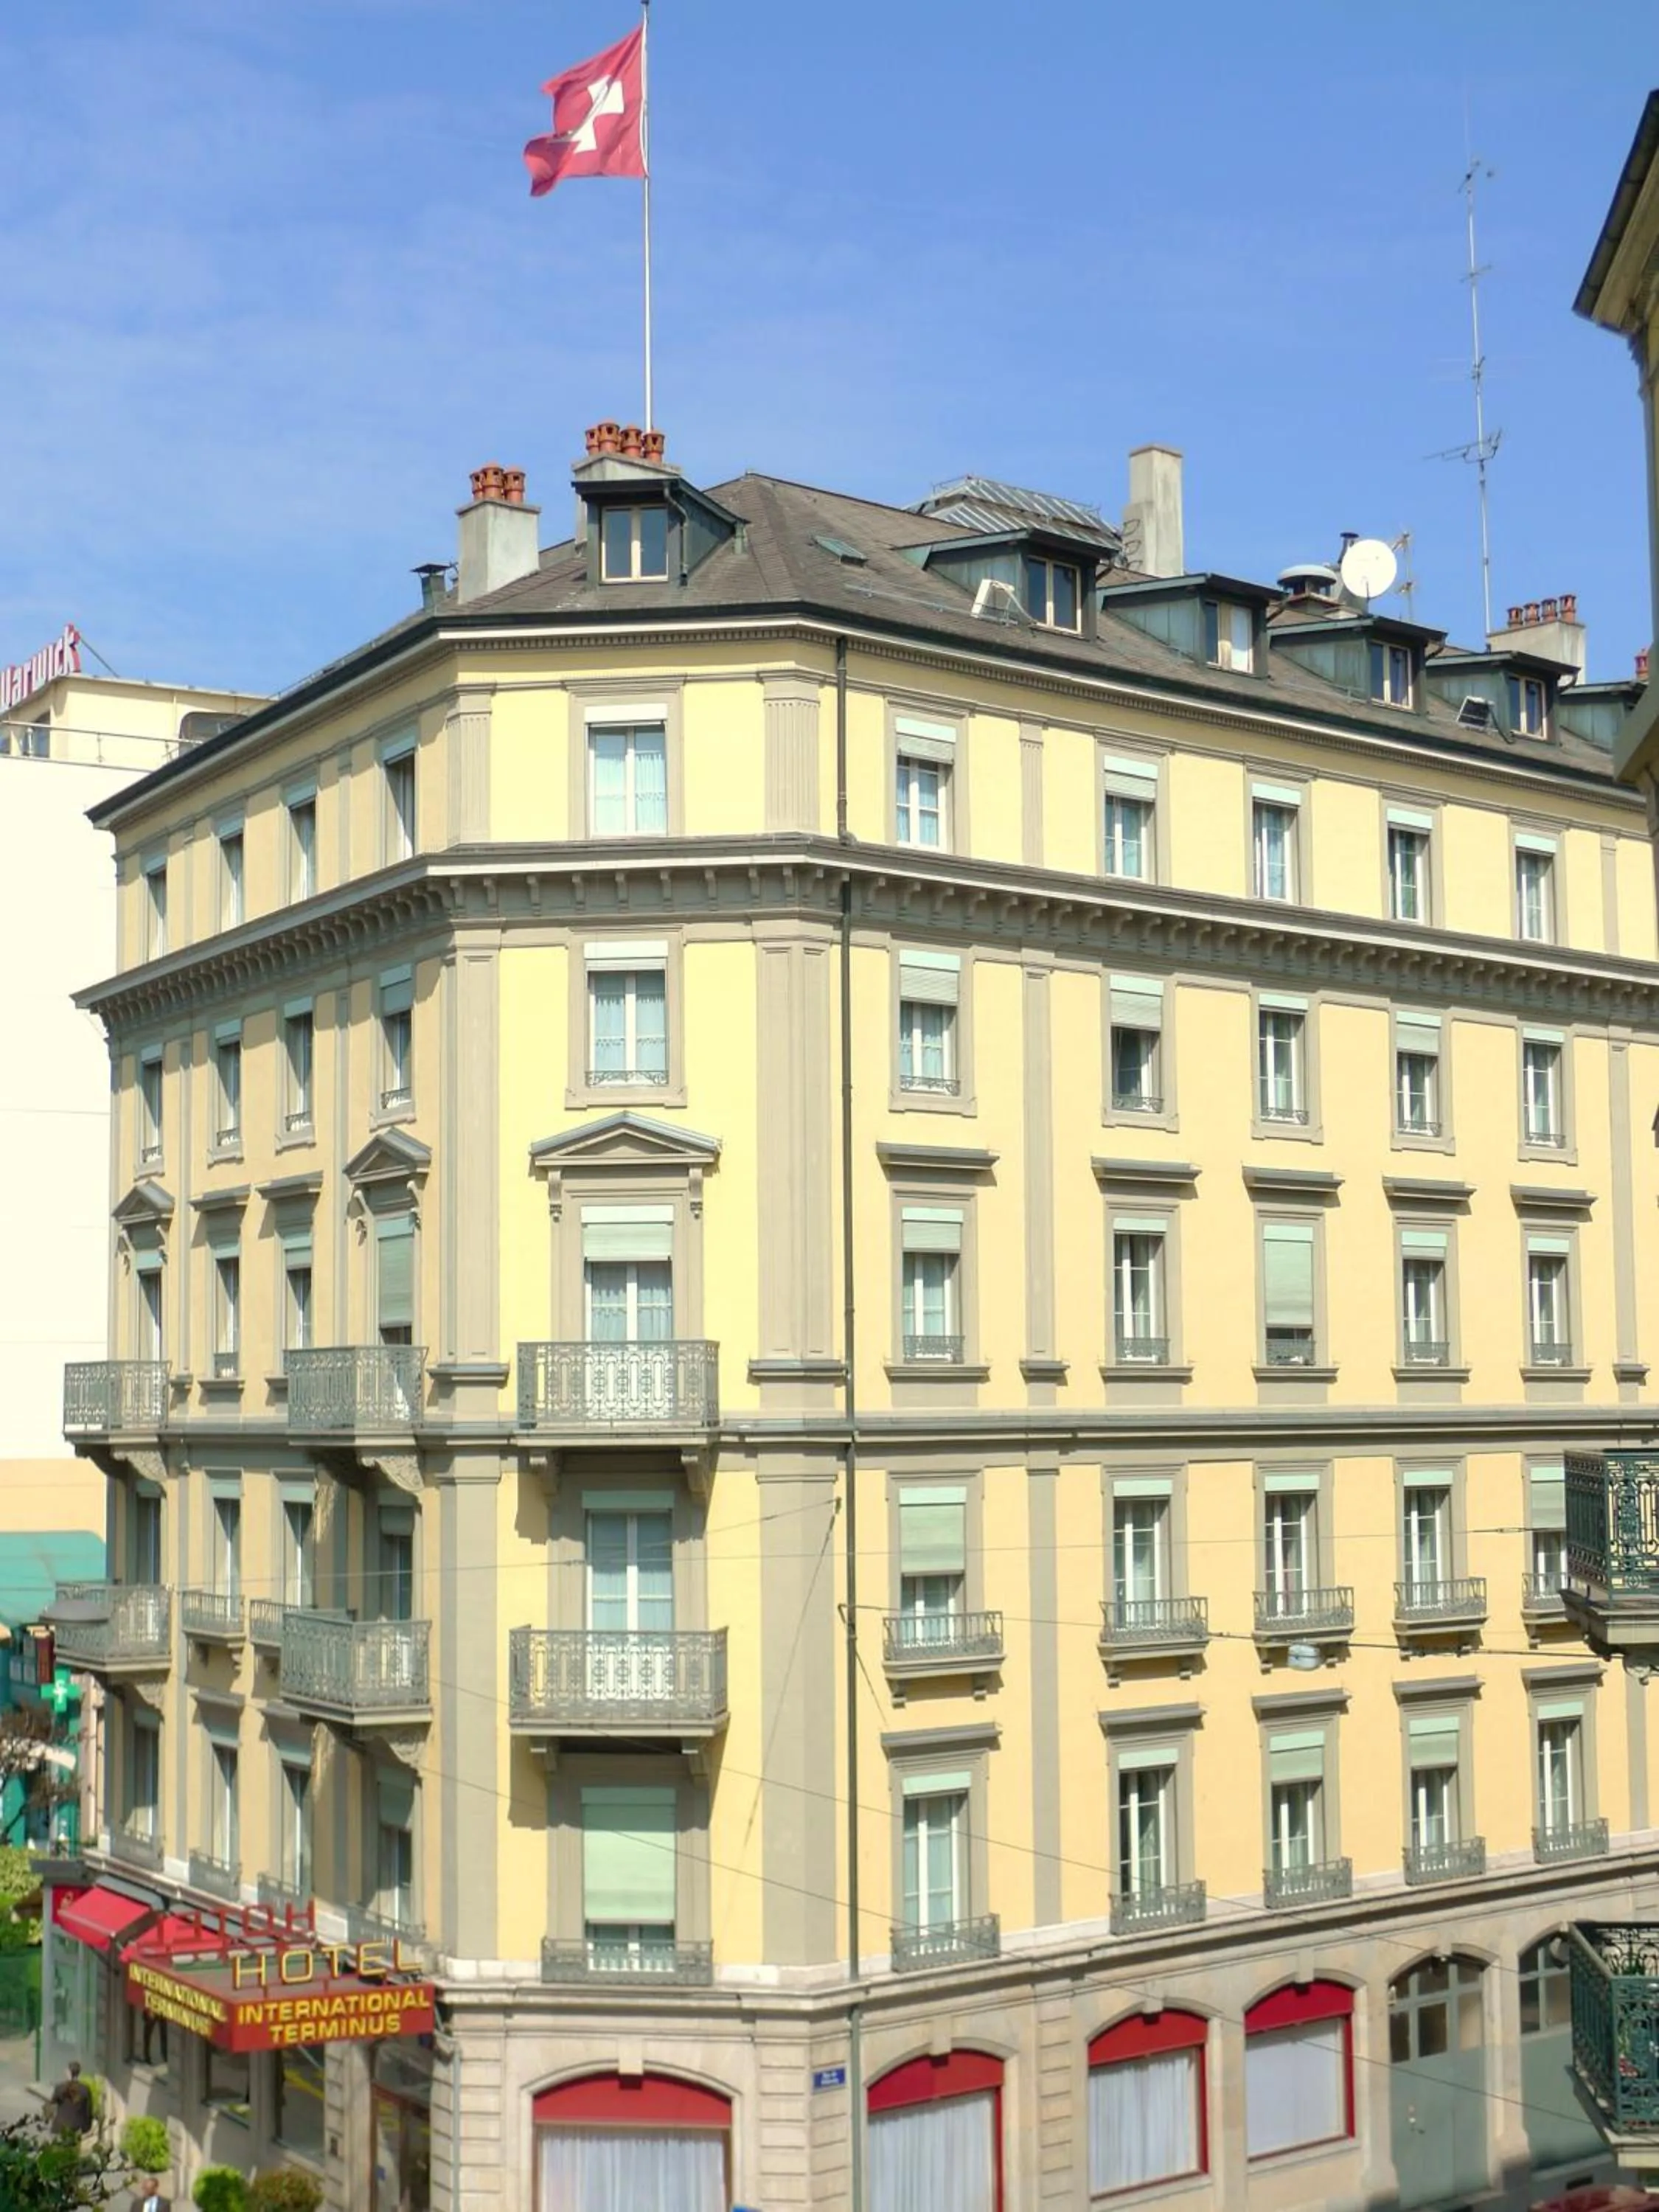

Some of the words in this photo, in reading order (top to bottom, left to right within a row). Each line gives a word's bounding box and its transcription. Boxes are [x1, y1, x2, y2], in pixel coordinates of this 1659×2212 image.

[233, 1938, 422, 1989] HOTEL
[129, 1962, 227, 2023] INTERNATIONAL
[145, 1989, 211, 2037] TERMINUS
[238, 1989, 430, 2025] INTERNATIONAL
[270, 2013, 400, 2044] TERMINUS
